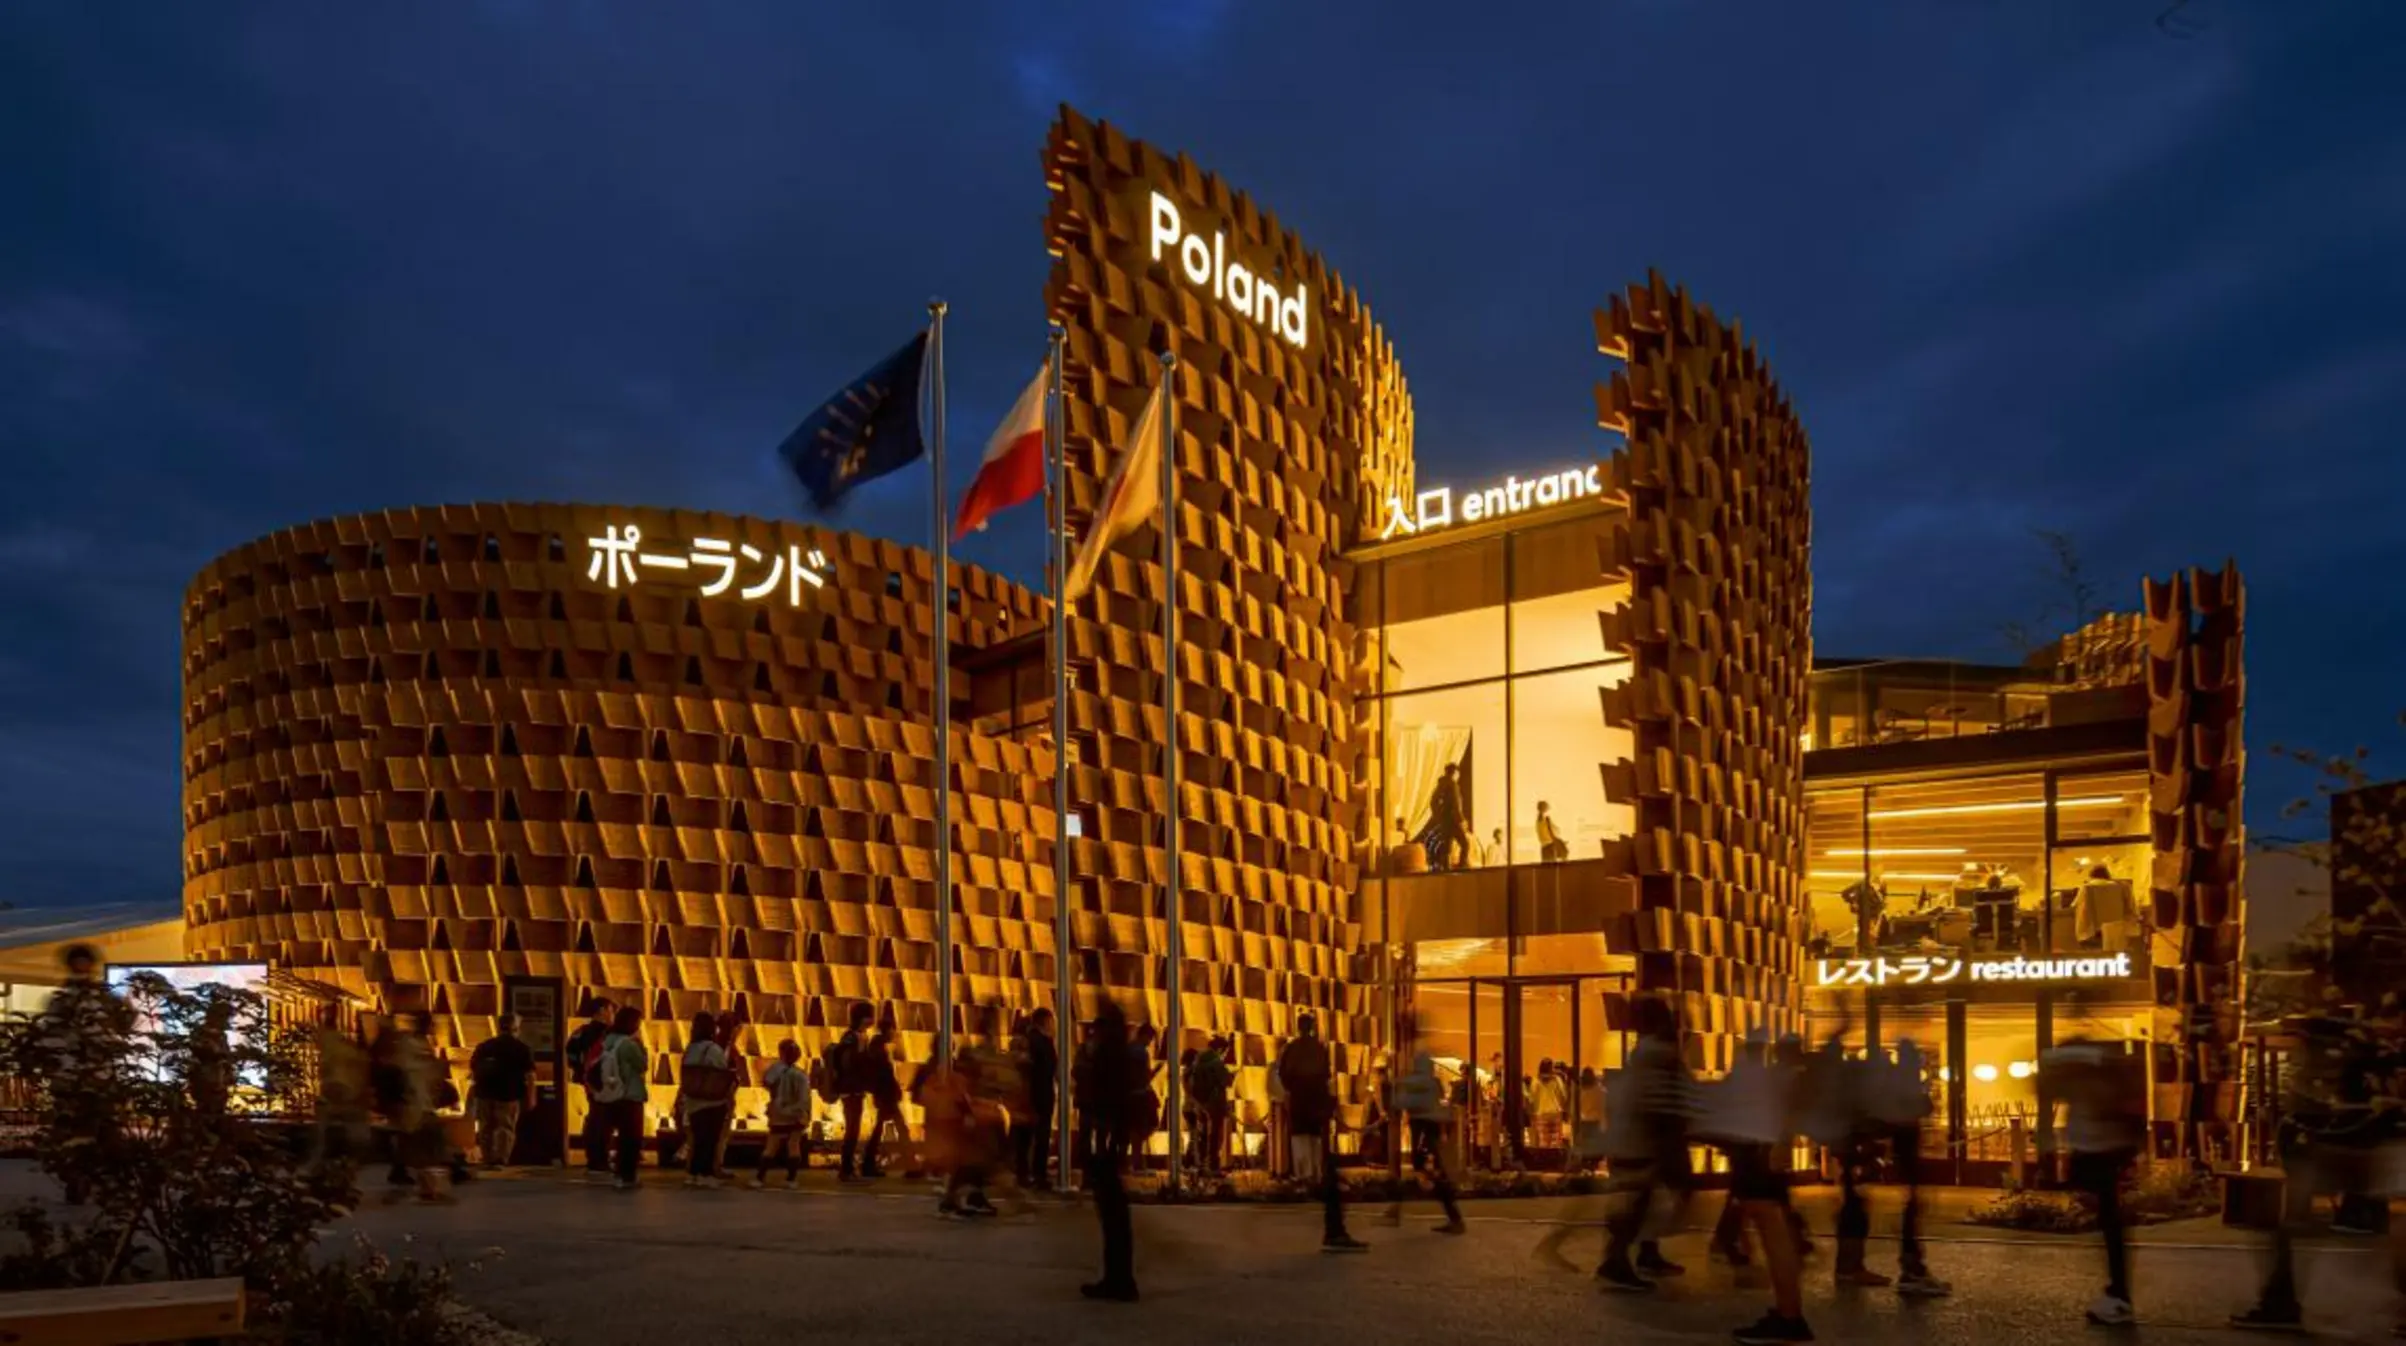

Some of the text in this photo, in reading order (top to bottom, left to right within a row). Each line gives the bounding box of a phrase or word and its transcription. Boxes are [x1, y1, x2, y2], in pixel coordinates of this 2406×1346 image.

[1151, 191, 1306, 348] Poland
[1381, 464, 1602, 539] 入口 entranc
[588, 525, 826, 606] ポーランド
[1818, 952, 2131, 985] レストラン restaurant
